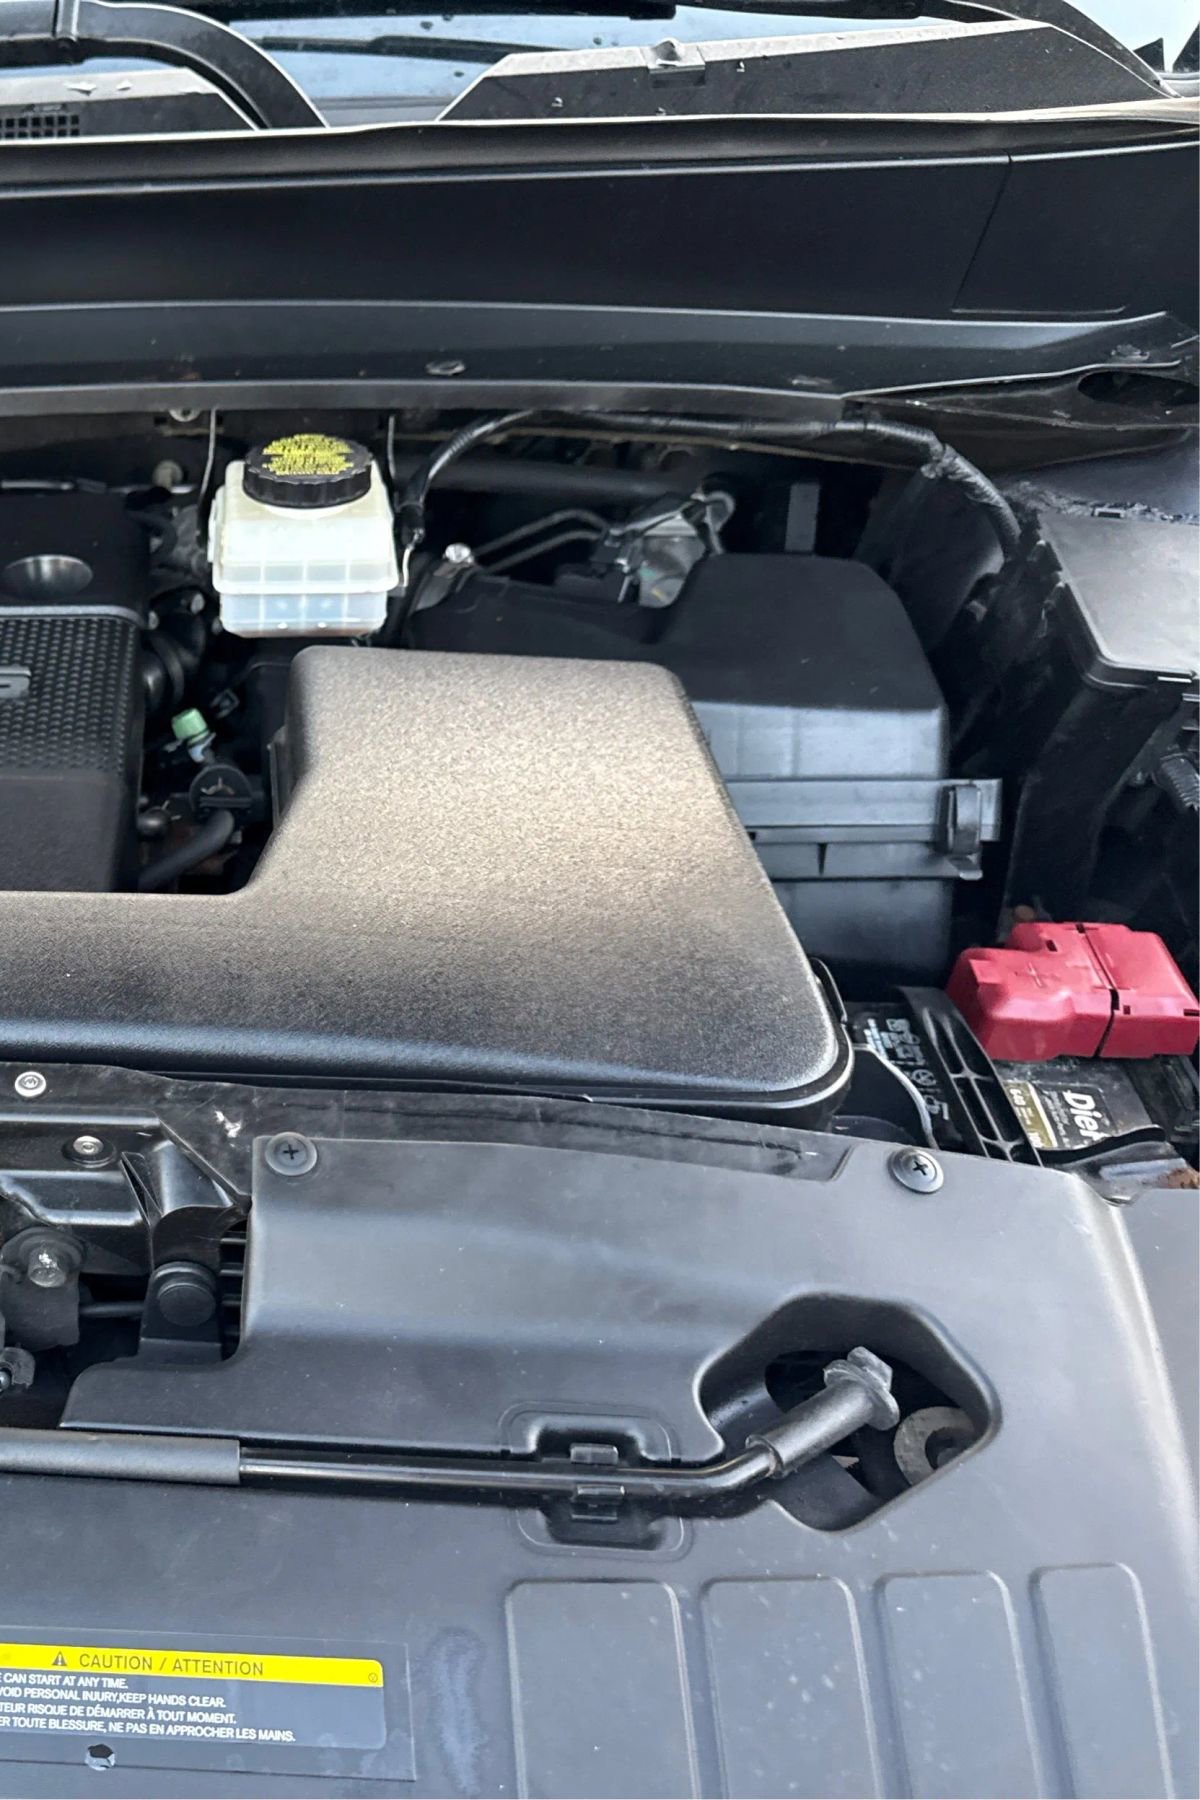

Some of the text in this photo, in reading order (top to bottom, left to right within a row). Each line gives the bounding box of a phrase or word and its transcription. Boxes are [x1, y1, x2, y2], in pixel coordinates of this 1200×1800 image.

[78, 1652, 264, 1677] CAUTION / ATTENTION
[3, 1672, 27, 1685] CAN
[28, 1673, 61, 1686] START
[62, 1675, 77, 1687] AT
[77, 1675, 101, 1689] ANY
[101, 1677, 129, 1690] TIME.
[23, 1687, 80, 1702] PERSONAL
[148, 1694, 187, 1707] HANDS
[187, 1695, 227, 1709] CLEAR.
[26, 1703, 69, 1717] RISQUE
[69, 1704, 85, 1718] DE
[85, 1703, 146, 1721] DÉMARRER
[146, 1705, 157, 1721] À
[157, 1709, 187, 1723] TOUT
[186, 1710, 238, 1725] MOMENT.
[12, 1716, 48, 1730] TOUTE
[48, 1717, 108, 1735] BLESSURE,
[108, 1721, 125, 1734] NE
[125, 1722, 149, 1735] PAS
[150, 1723, 166, 1736] EN
[166, 1724, 235, 1740] APPROCHER
[235, 1727, 257, 1740] LES
[257, 1728, 297, 1743] MAINS.
